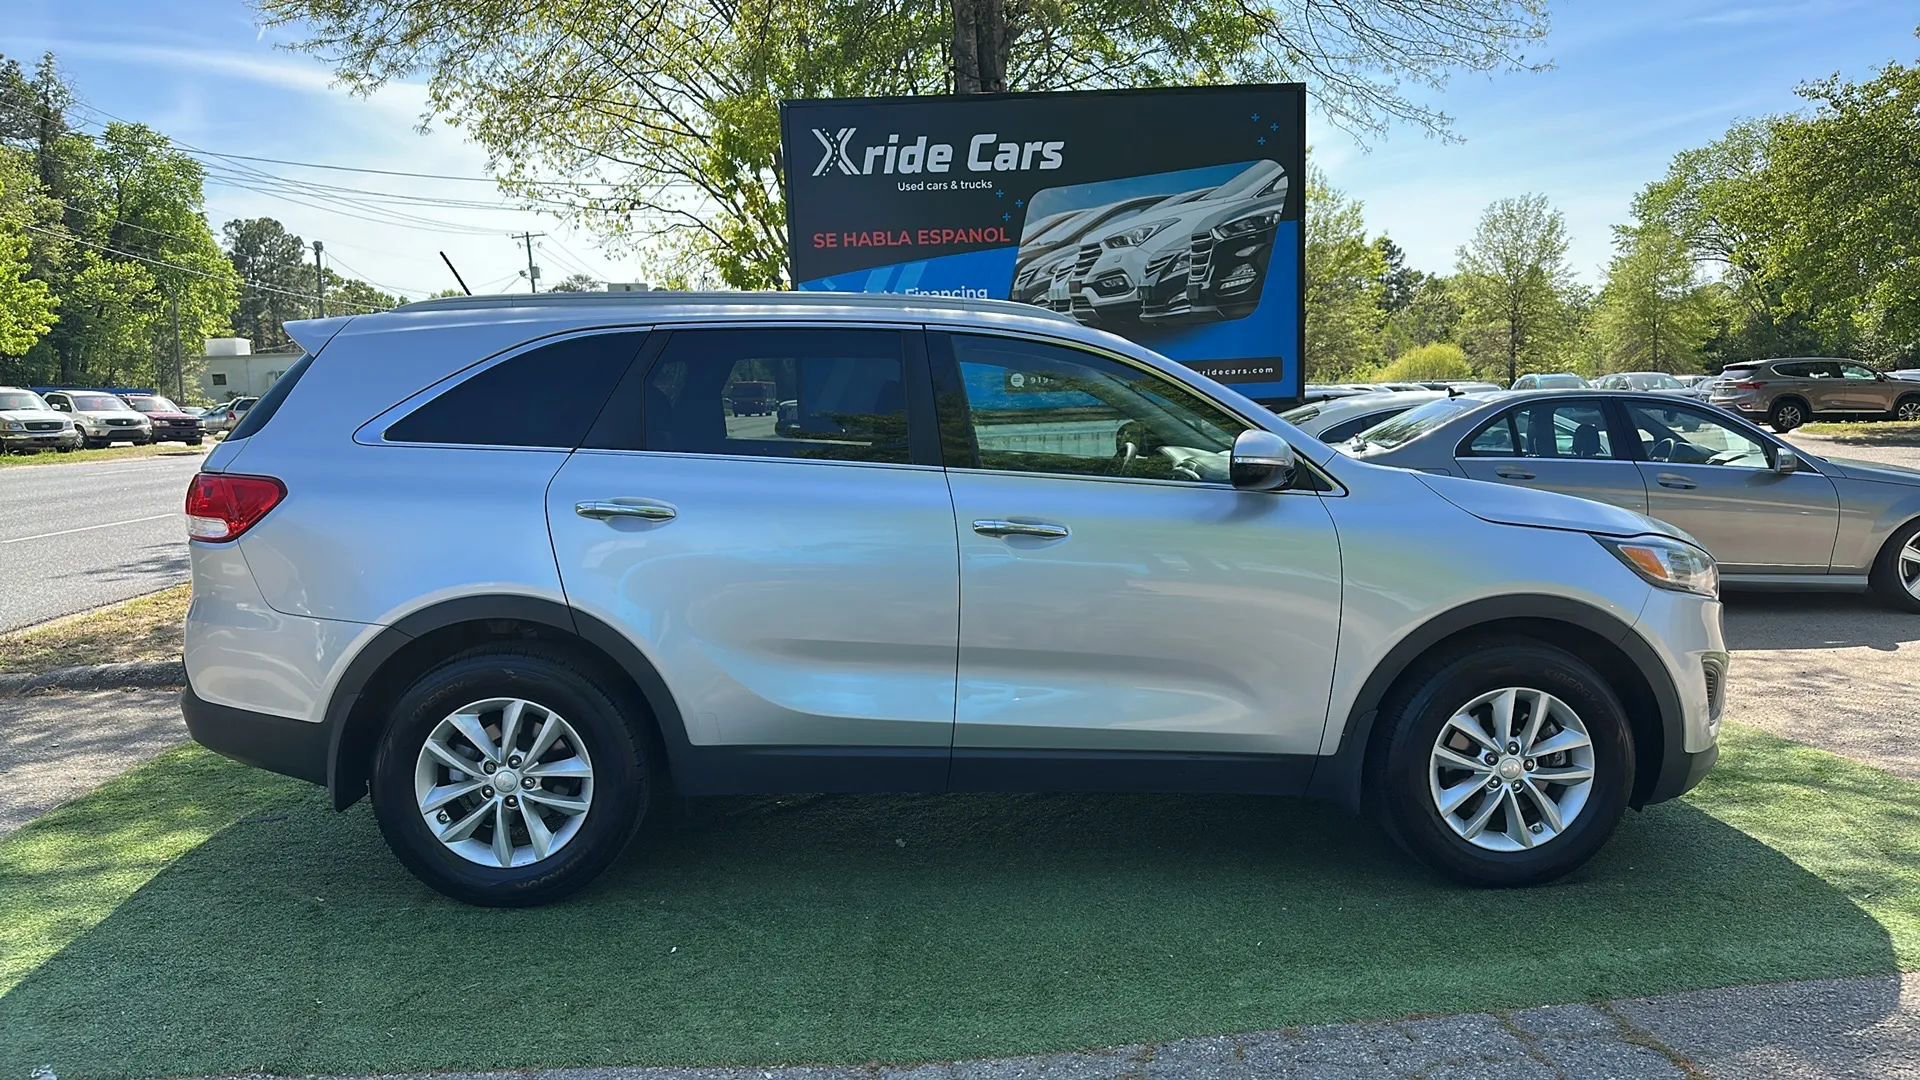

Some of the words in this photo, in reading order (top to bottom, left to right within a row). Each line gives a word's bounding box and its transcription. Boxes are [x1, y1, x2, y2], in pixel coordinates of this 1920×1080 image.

[967, 134, 1065, 171] Cars
[897, 181, 924, 191] Used
[926, 182, 948, 190] cars
[950, 181, 958, 189] &
[960, 179, 993, 189] trucks
[813, 232, 837, 248] SE
[843, 231, 912, 247] HABLA
[918, 227, 1011, 245] ESPANOL
[1198, 367, 1274, 376] ridecars.com
